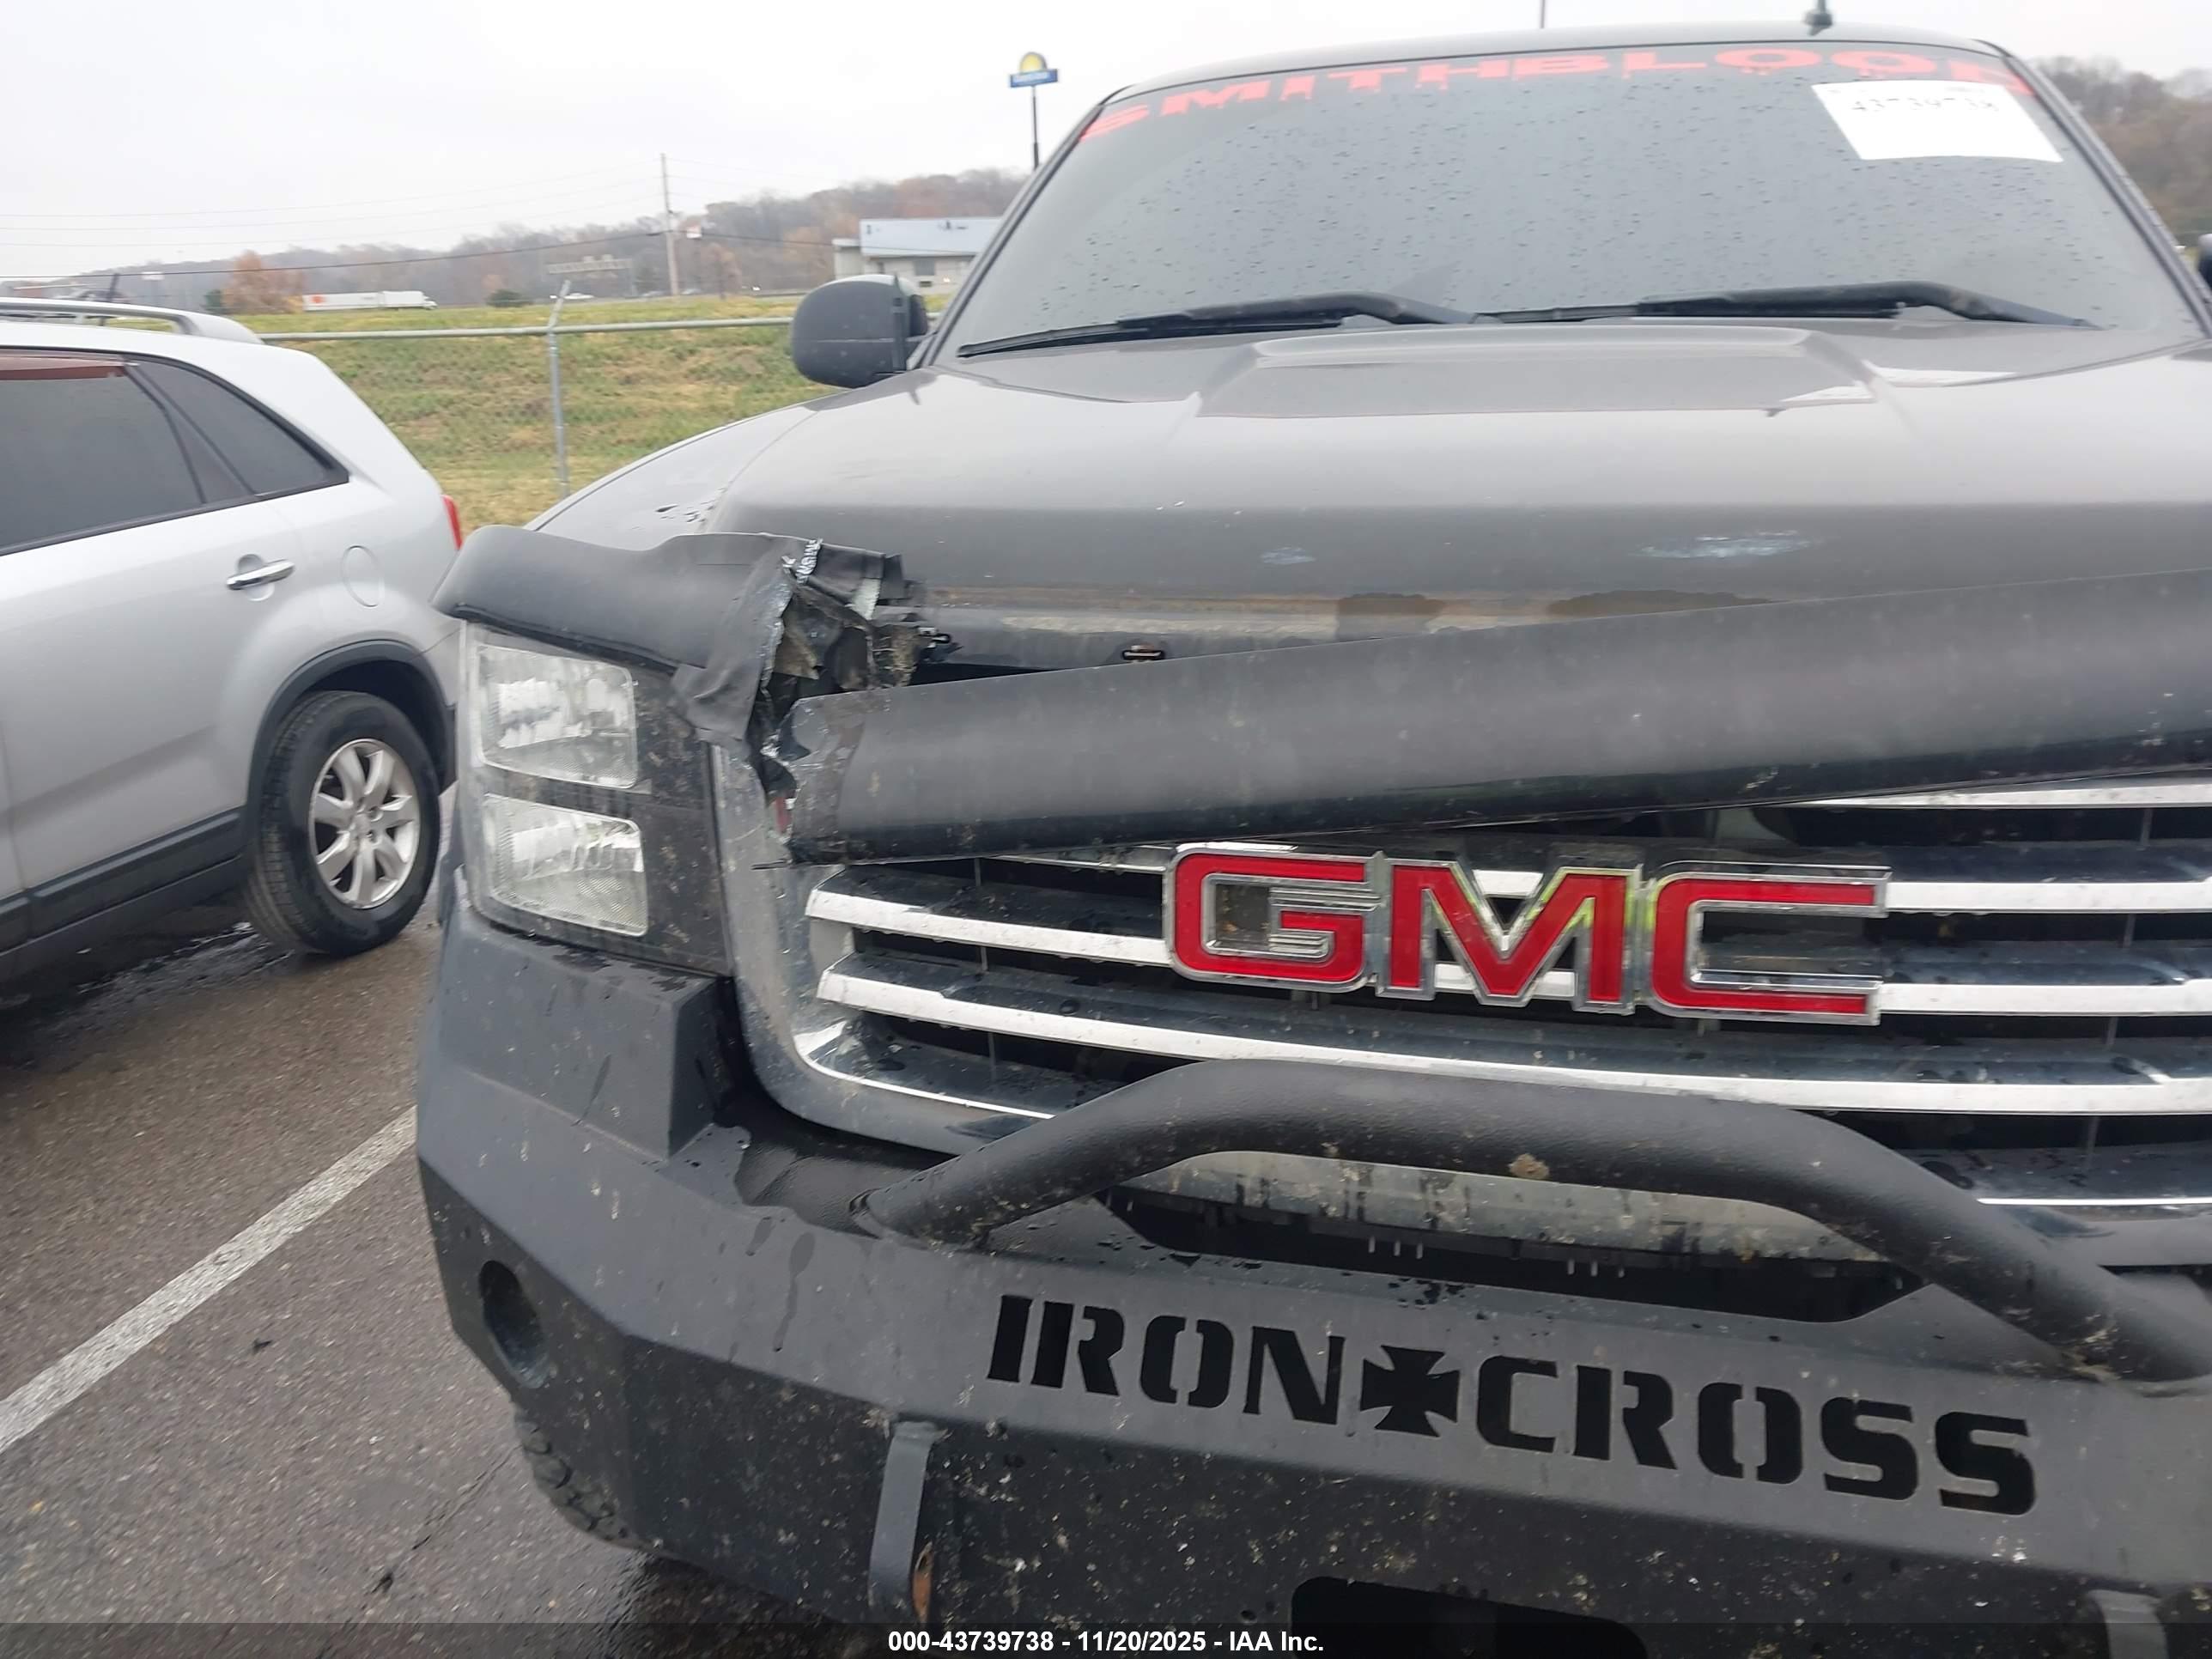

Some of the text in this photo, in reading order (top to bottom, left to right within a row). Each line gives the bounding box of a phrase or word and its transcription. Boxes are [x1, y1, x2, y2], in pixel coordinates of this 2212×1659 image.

[1170, 842, 1891, 1025] GMC
[986, 1295, 2037, 1516] IRON CROSS
